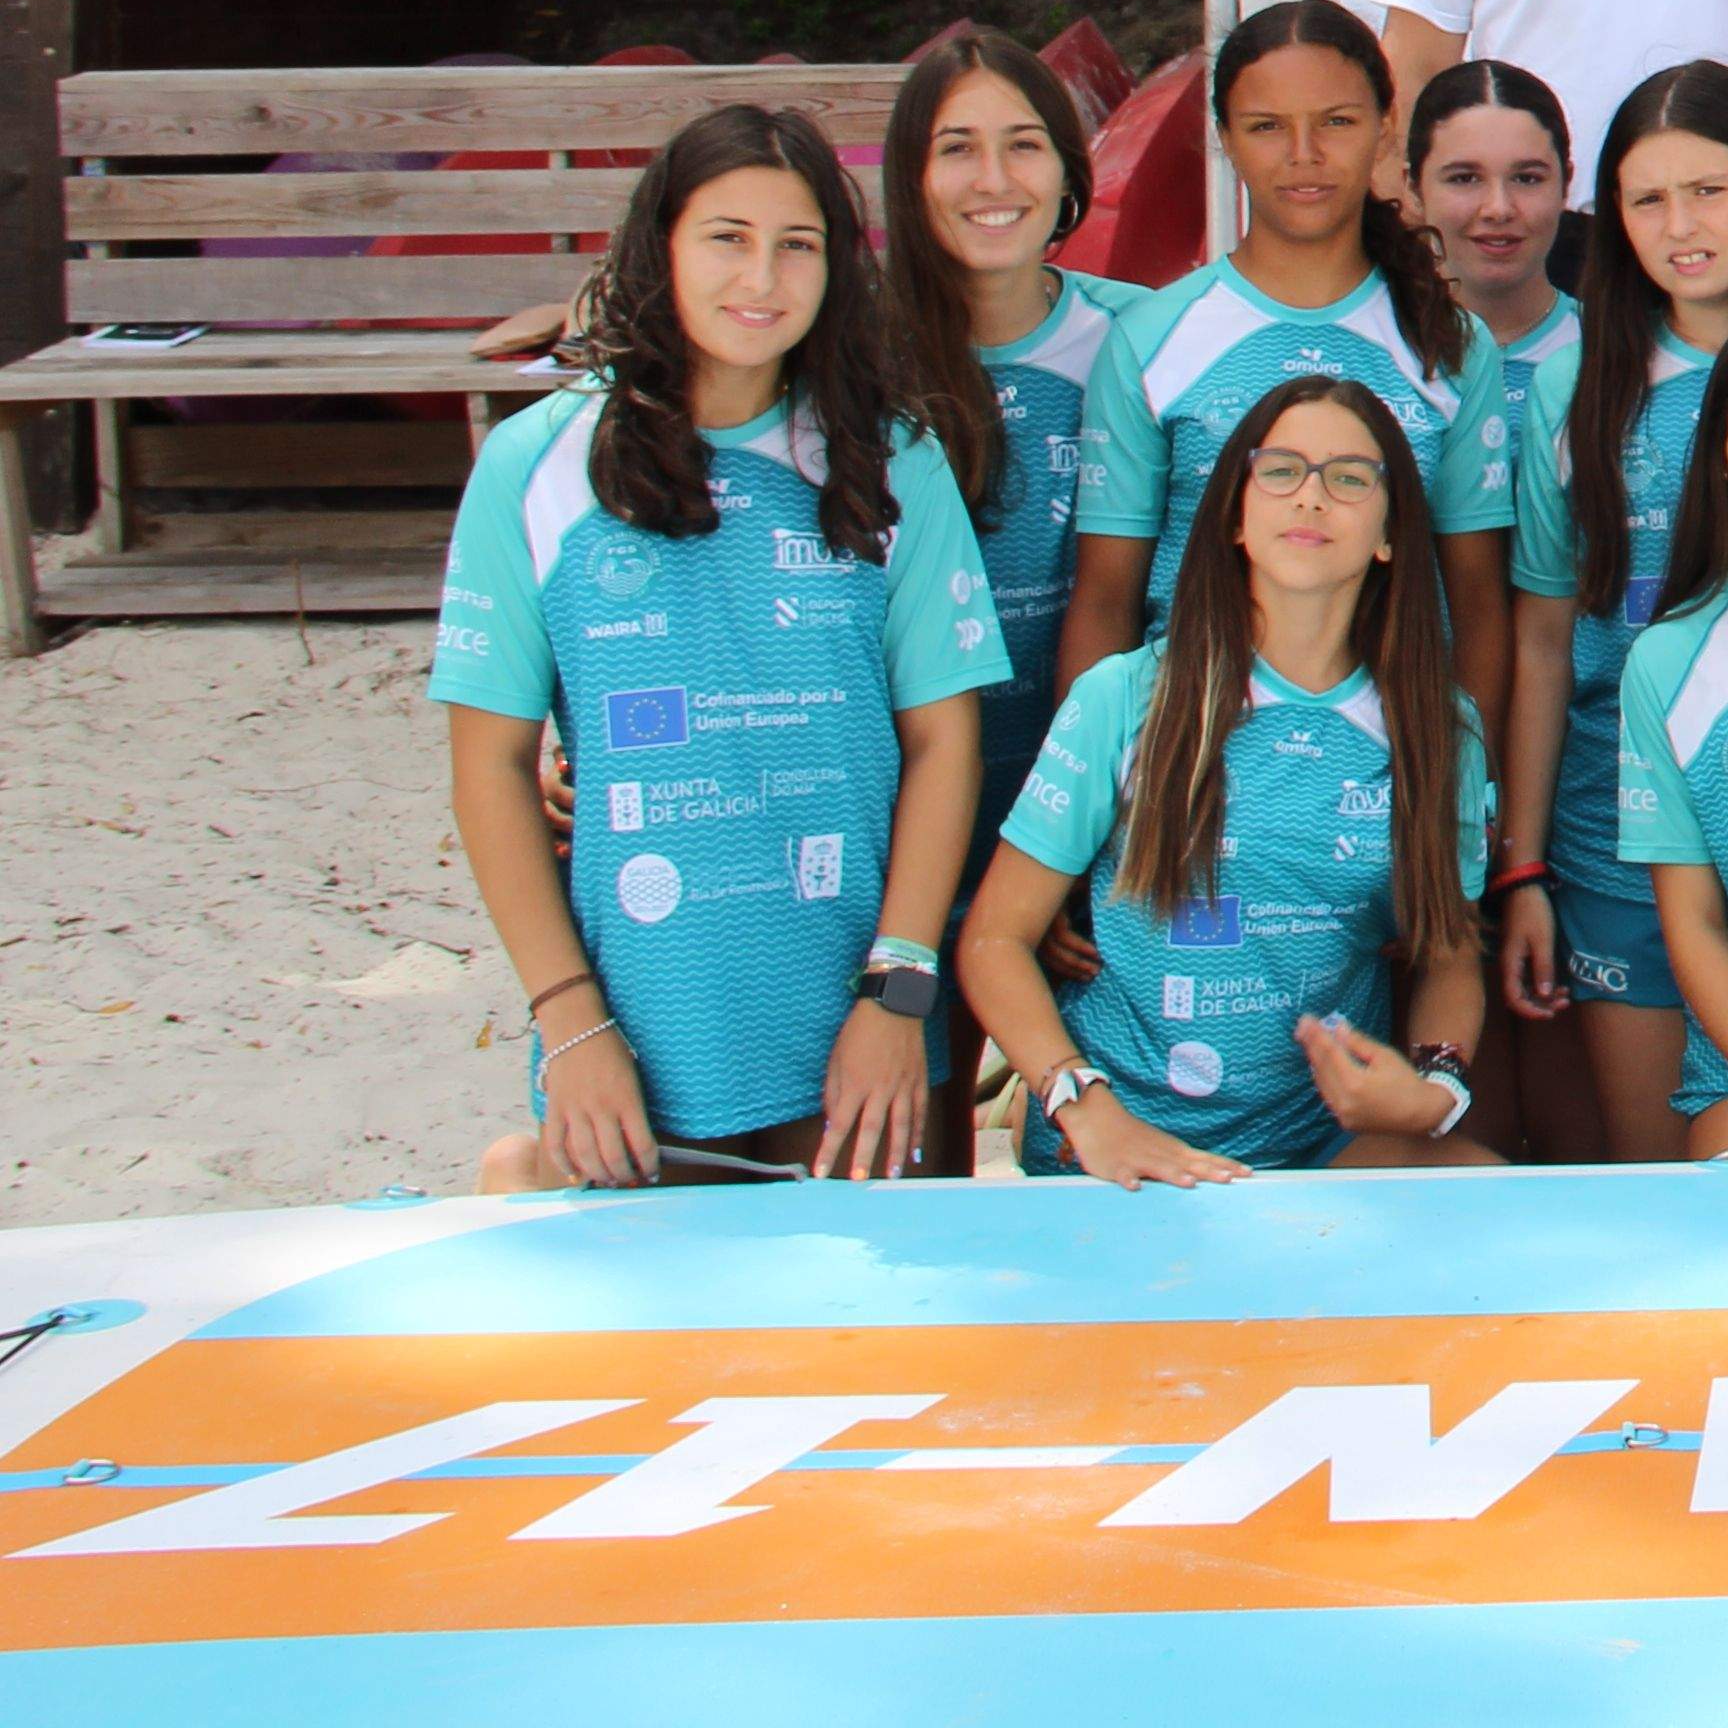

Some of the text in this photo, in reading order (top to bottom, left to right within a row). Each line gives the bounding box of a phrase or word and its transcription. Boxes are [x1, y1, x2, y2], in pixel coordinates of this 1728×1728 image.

[1283, 358, 1344, 374] amura
[584, 621, 642, 640] WAIRA
[693, 687, 847, 709] Cofinanciado por la
[694, 711, 810, 731] Unión Europea
[649, 778, 721, 802] XUNTA
[1024, 772, 1071, 815] nce
[649, 796, 760, 824] DE GALICIA
[1200, 976, 1268, 997] XUNTA
[1200, 998, 1227, 1016] DE
